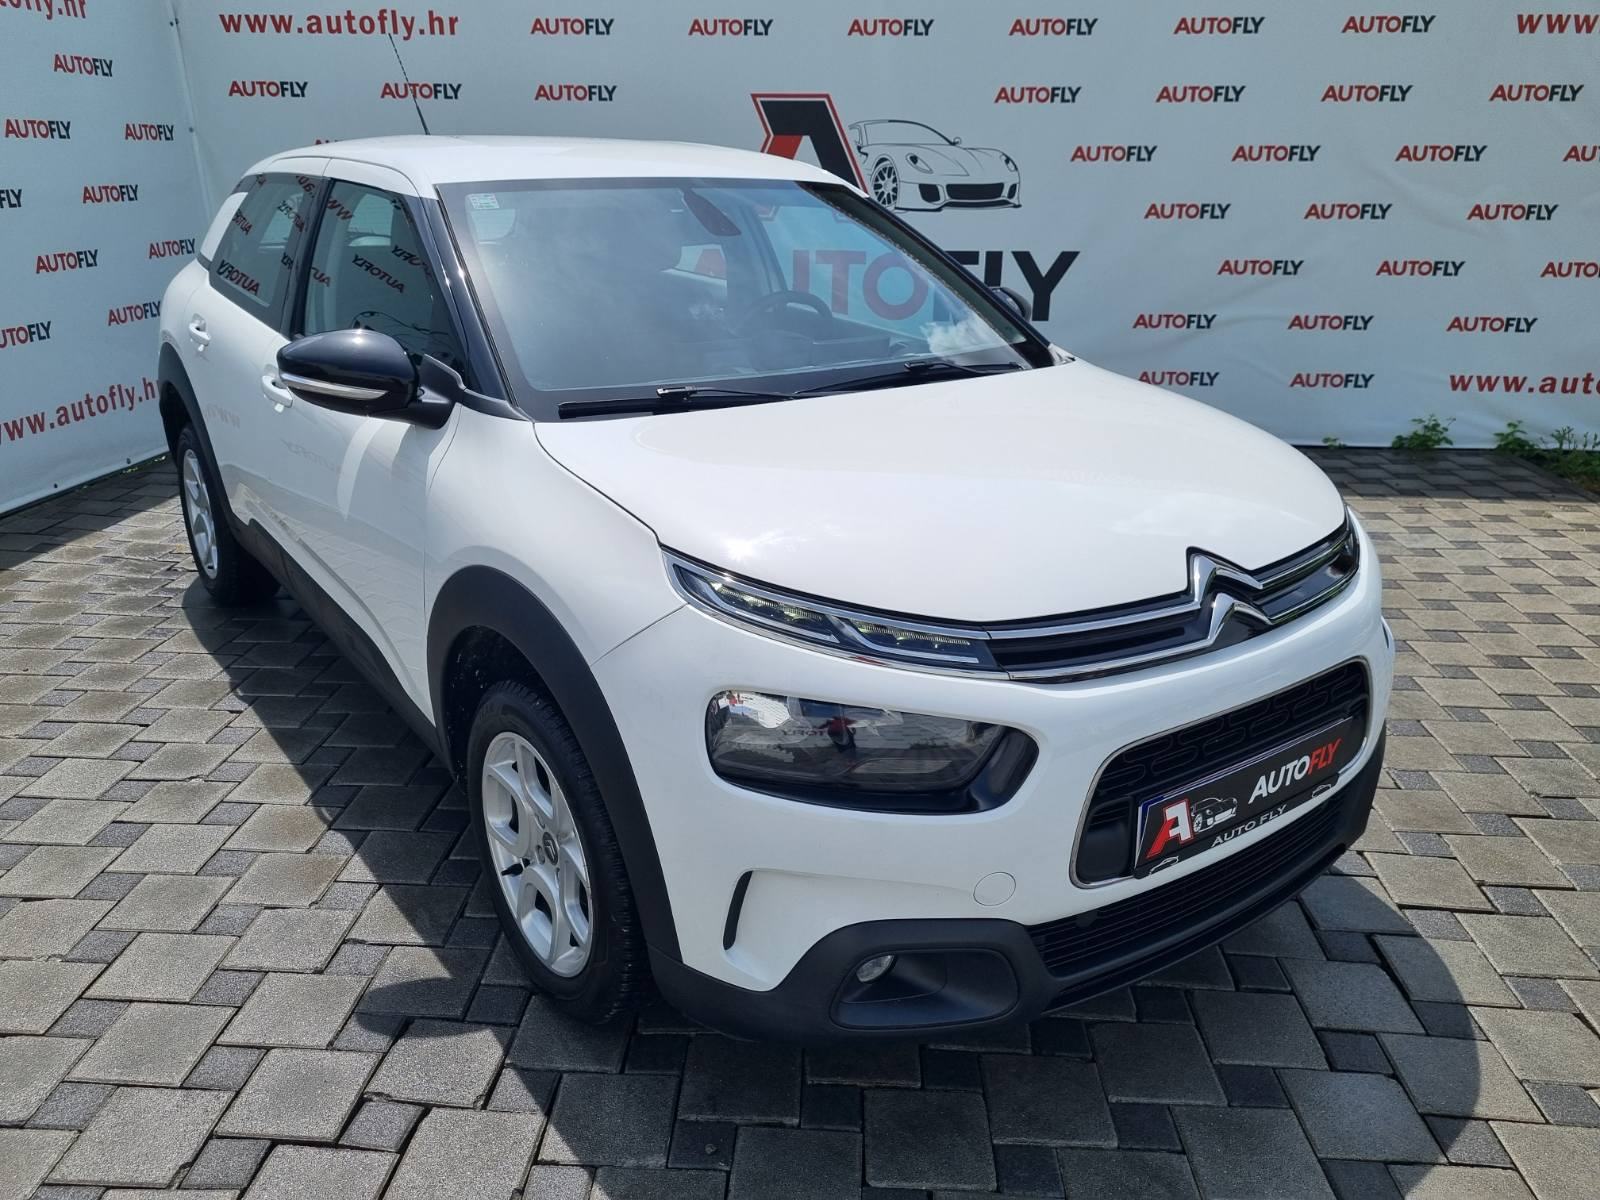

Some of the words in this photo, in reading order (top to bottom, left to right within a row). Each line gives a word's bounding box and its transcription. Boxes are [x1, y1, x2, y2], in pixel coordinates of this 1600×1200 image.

[219, 9, 459, 40] www.autofly.hr
[531, 19, 614, 35] AUTOFLY
[689, 19, 773, 36] AUTOFLY
[848, 19, 934, 36] AUTOFLY
[1009, 18, 1098, 35] AUTOFLY
[1174, 17, 1265, 34] AUTOFLY
[1342, 16, 1436, 33] AUTOFLY
[54, 54, 112, 77] AUTOFLY
[229, 81, 307, 97] AUTOFLY
[381, 83, 462, 100] AUTOFLY
[535, 85, 616, 101] AUTOFLY
[995, 87, 1081, 103] AUTOFLY
[1156, 86, 1245, 102] AUTOFLY
[1322, 85, 1412, 101] AUTOFLY
[1490, 85, 1584, 101] AUTOFLY
[6, 119, 70, 139] AUTOFLY
[125, 124, 174, 141] AUTOFLY
[1071, 146, 1157, 161] AUTOFLY
[1232, 146, 1320, 161] AUTOFLY
[1396, 145, 1487, 161] AUTOFLY
[1562, 145, 1600, 162] AU
[83, 185, 138, 203] AUTOFLY
[1144, 204, 1231, 219] AUTOFLY
[1304, 204, 1392, 219] AUTOFLY
[1468, 205, 1558, 220] AUTOFLY
[148, 239, 195, 259] AUTOFLY
[36, 249, 98, 274] AUTOFLY
[1218, 260, 1304, 275] AUTOFLY
[1376, 261, 1465, 276] AUTOFLY
[1541, 262, 1600, 278] AUTO
[108, 301, 160, 326] AUTOFLY
[1133, 314, 1216, 329] AUTOFLY
[1288, 316, 1373, 330] AUTOFLY
[1447, 317, 1538, 332] AUTOFLY
[1139, 371, 1219, 386] AUTOFLY
[1290, 374, 1374, 388] AUTOFLY
[1450, 372, 1600, 396] www.aut
[0, 377, 159, 445] ww.autofly.h
[1248, 738, 1343, 805] AUTOFLY
[1211, 820, 1257, 848] AUTO
[1259, 803, 1288, 825] FLY
